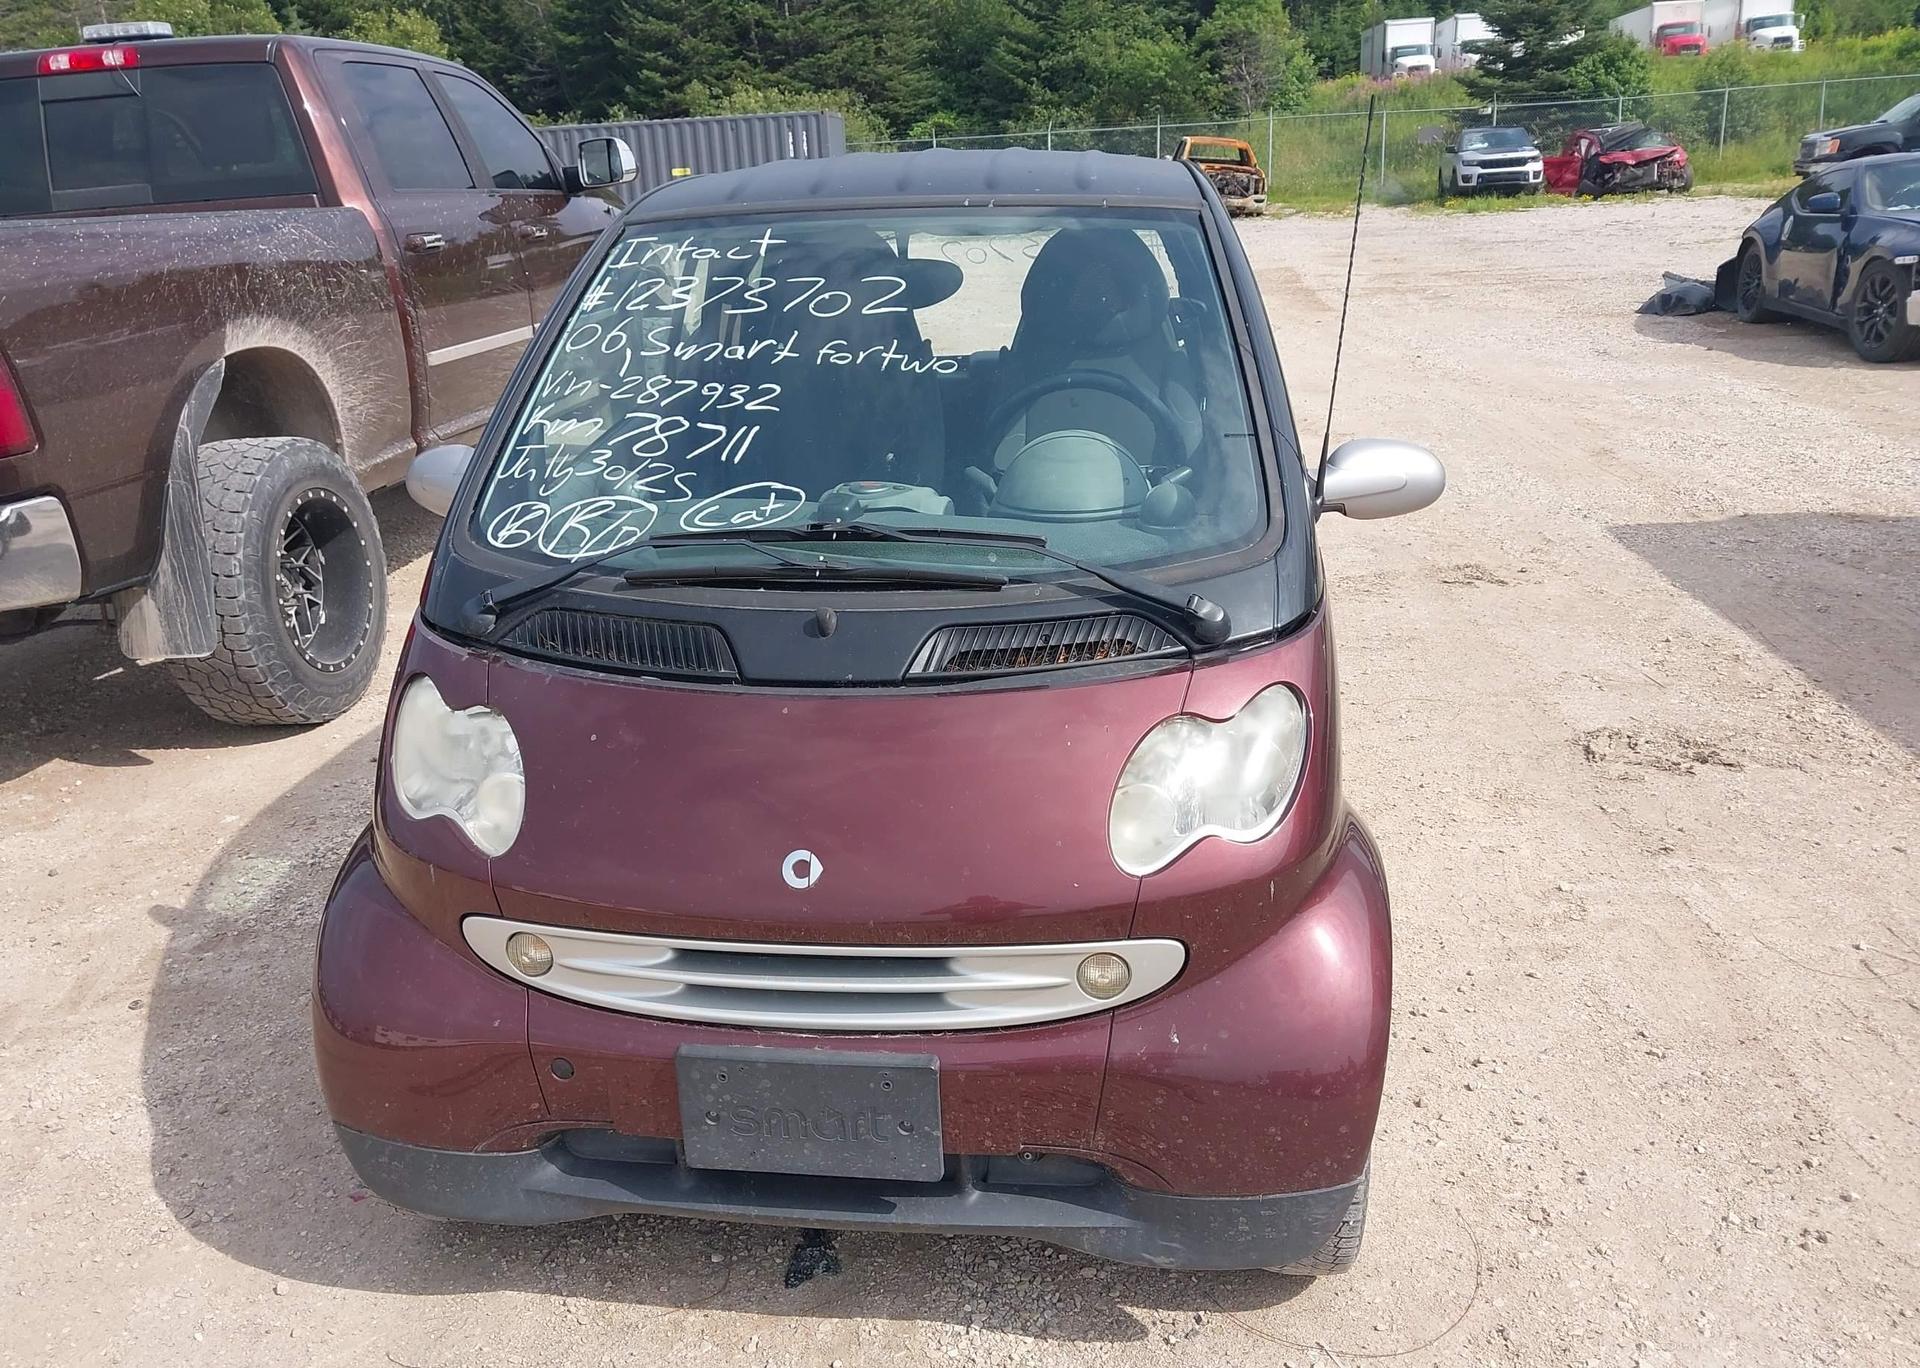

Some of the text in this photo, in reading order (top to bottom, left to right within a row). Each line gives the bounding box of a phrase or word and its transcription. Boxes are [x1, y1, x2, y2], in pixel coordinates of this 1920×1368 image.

[609, 228, 787, 269] Intact
[581, 275, 909, 318] #12373702
[607, 412, 760, 464] 78711
[730, 1105, 892, 1143] smart
